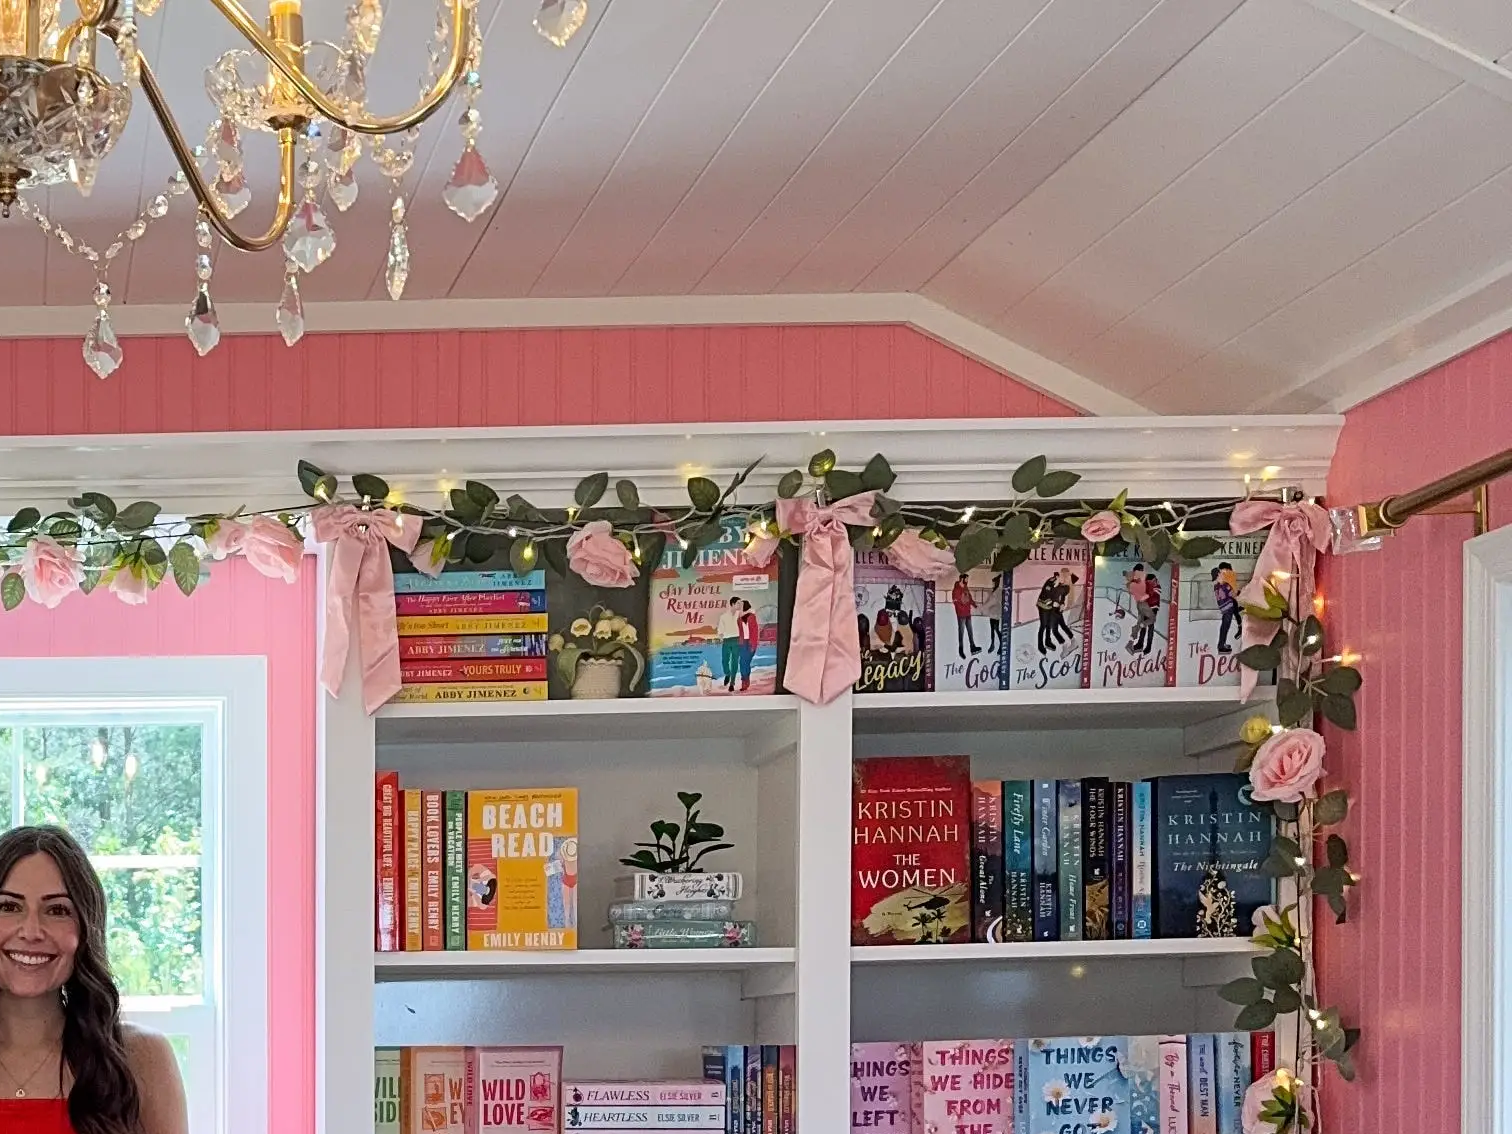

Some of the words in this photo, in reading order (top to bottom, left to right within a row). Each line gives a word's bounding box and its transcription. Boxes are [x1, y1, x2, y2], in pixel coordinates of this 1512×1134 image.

[667, 598, 728, 614] REMEMBER
[407, 645, 434, 655] ABBY
[438, 642, 485, 655] JIMENEZ
[1097, 650, 1118, 664] The
[1187, 642, 1207, 658] The
[463, 665, 494, 677] YOURS
[496, 664, 523, 676] TRULY
[854, 650, 926, 691] Legacy
[435, 690, 464, 700] ABBY
[467, 688, 518, 698] JIMENEZ
[426, 794, 439, 822] BOOK
[482, 802, 563, 830] BEACH
[858, 799, 954, 820] KRISTIN
[1011, 792, 1025, 825] Firefly
[407, 810, 420, 838] HAPPY
[1168, 811, 1262, 826] KRISTIN
[854, 824, 959, 844] HANNAH
[1013, 829, 1024, 854] Lane
[1168, 831, 1262, 846] HANNAH
[426, 825, 439, 863] LOVERS
[491, 832, 554, 858] READ
[406, 840, 419, 869] PLACE
[893, 853, 921, 866] THE
[427, 870, 439, 897] EMILY
[859, 867, 956, 888] WOMEN
[427, 901, 439, 931] HENRY
[483, 934, 521, 948] EMILY
[524, 931, 566, 948] HENRY
[936, 1048, 1011, 1067] THINGS
[1041, 1046, 1118, 1065] THINGS
[481, 1078, 526, 1102] WILD
[930, 1074, 961, 1092] WE
[972, 1072, 1016, 1090] HIDE
[1063, 1072, 1096, 1089] WE
[860, 1085, 890, 1102] WE
[483, 1102, 526, 1126] LOVE
[945, 1098, 1001, 1116] FROM
[1046, 1097, 1114, 1116] NEVER
[852, 1110, 899, 1127] LEFT
